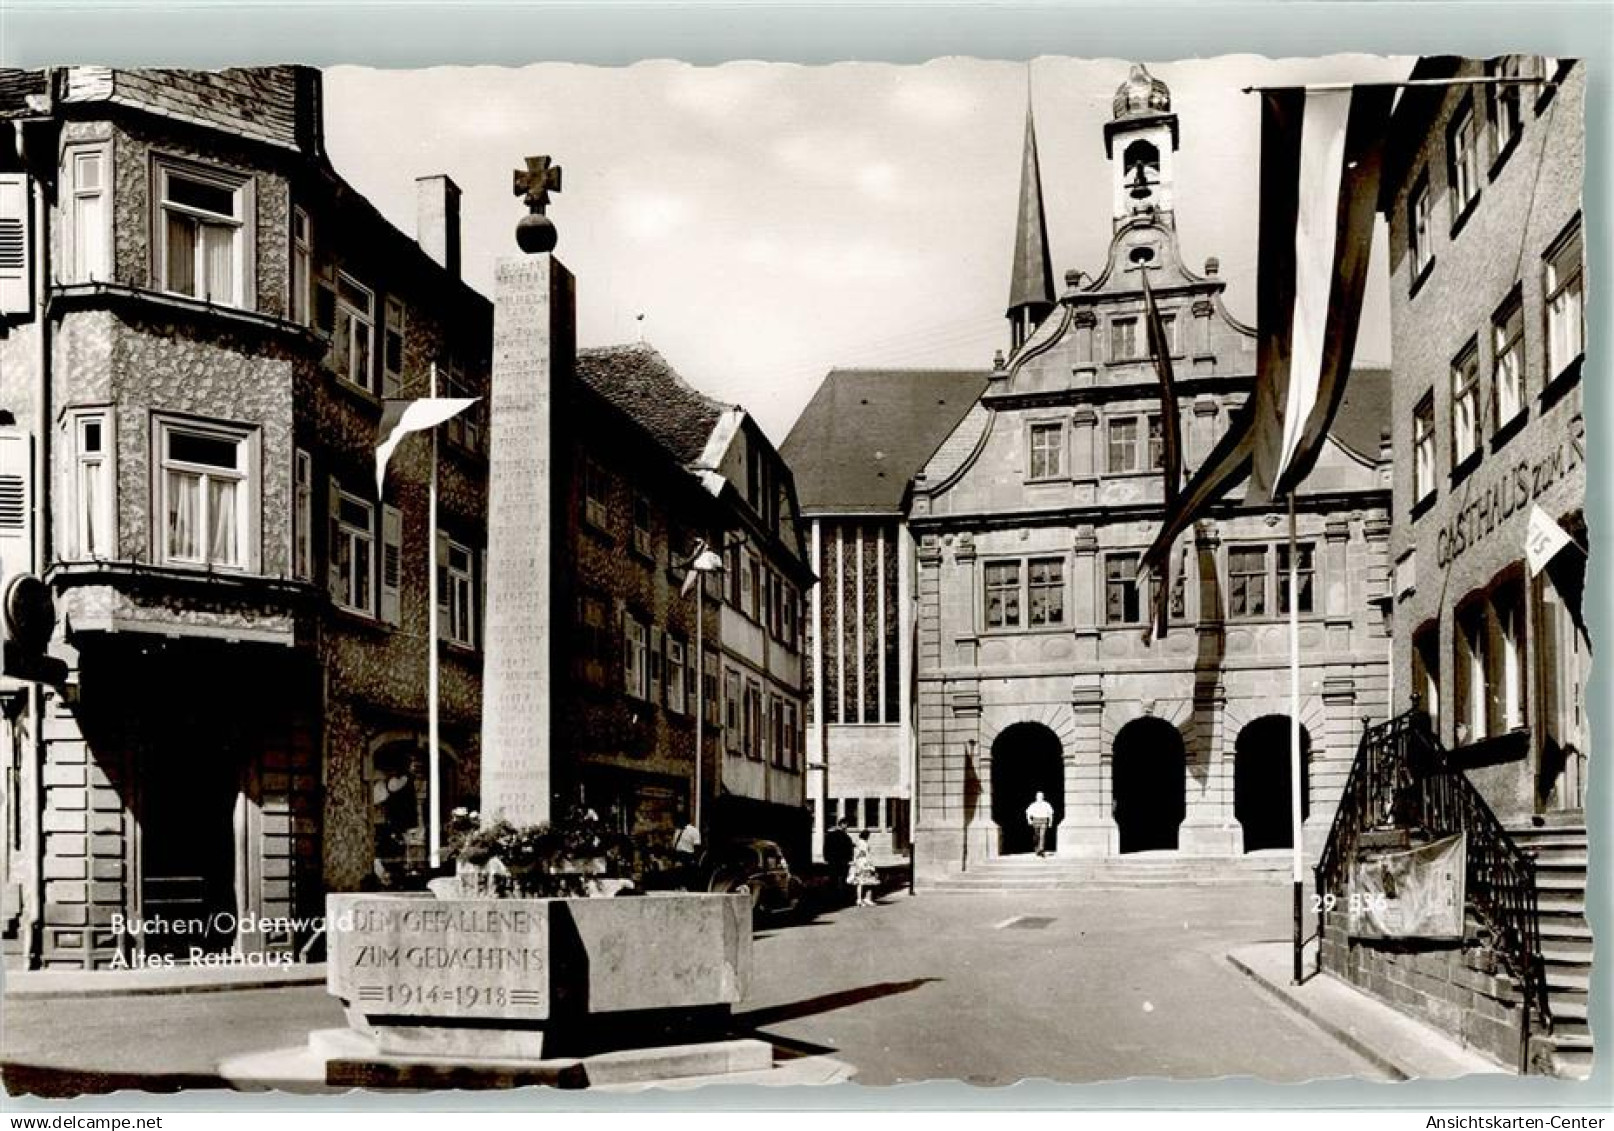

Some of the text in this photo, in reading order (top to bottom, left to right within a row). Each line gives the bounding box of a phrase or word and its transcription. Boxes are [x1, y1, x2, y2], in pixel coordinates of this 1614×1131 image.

[1436, 461, 1529, 569] GASTHAUS
[403, 909, 543, 933] GEFALLENEN
[355, 945, 399, 968] ZUM
